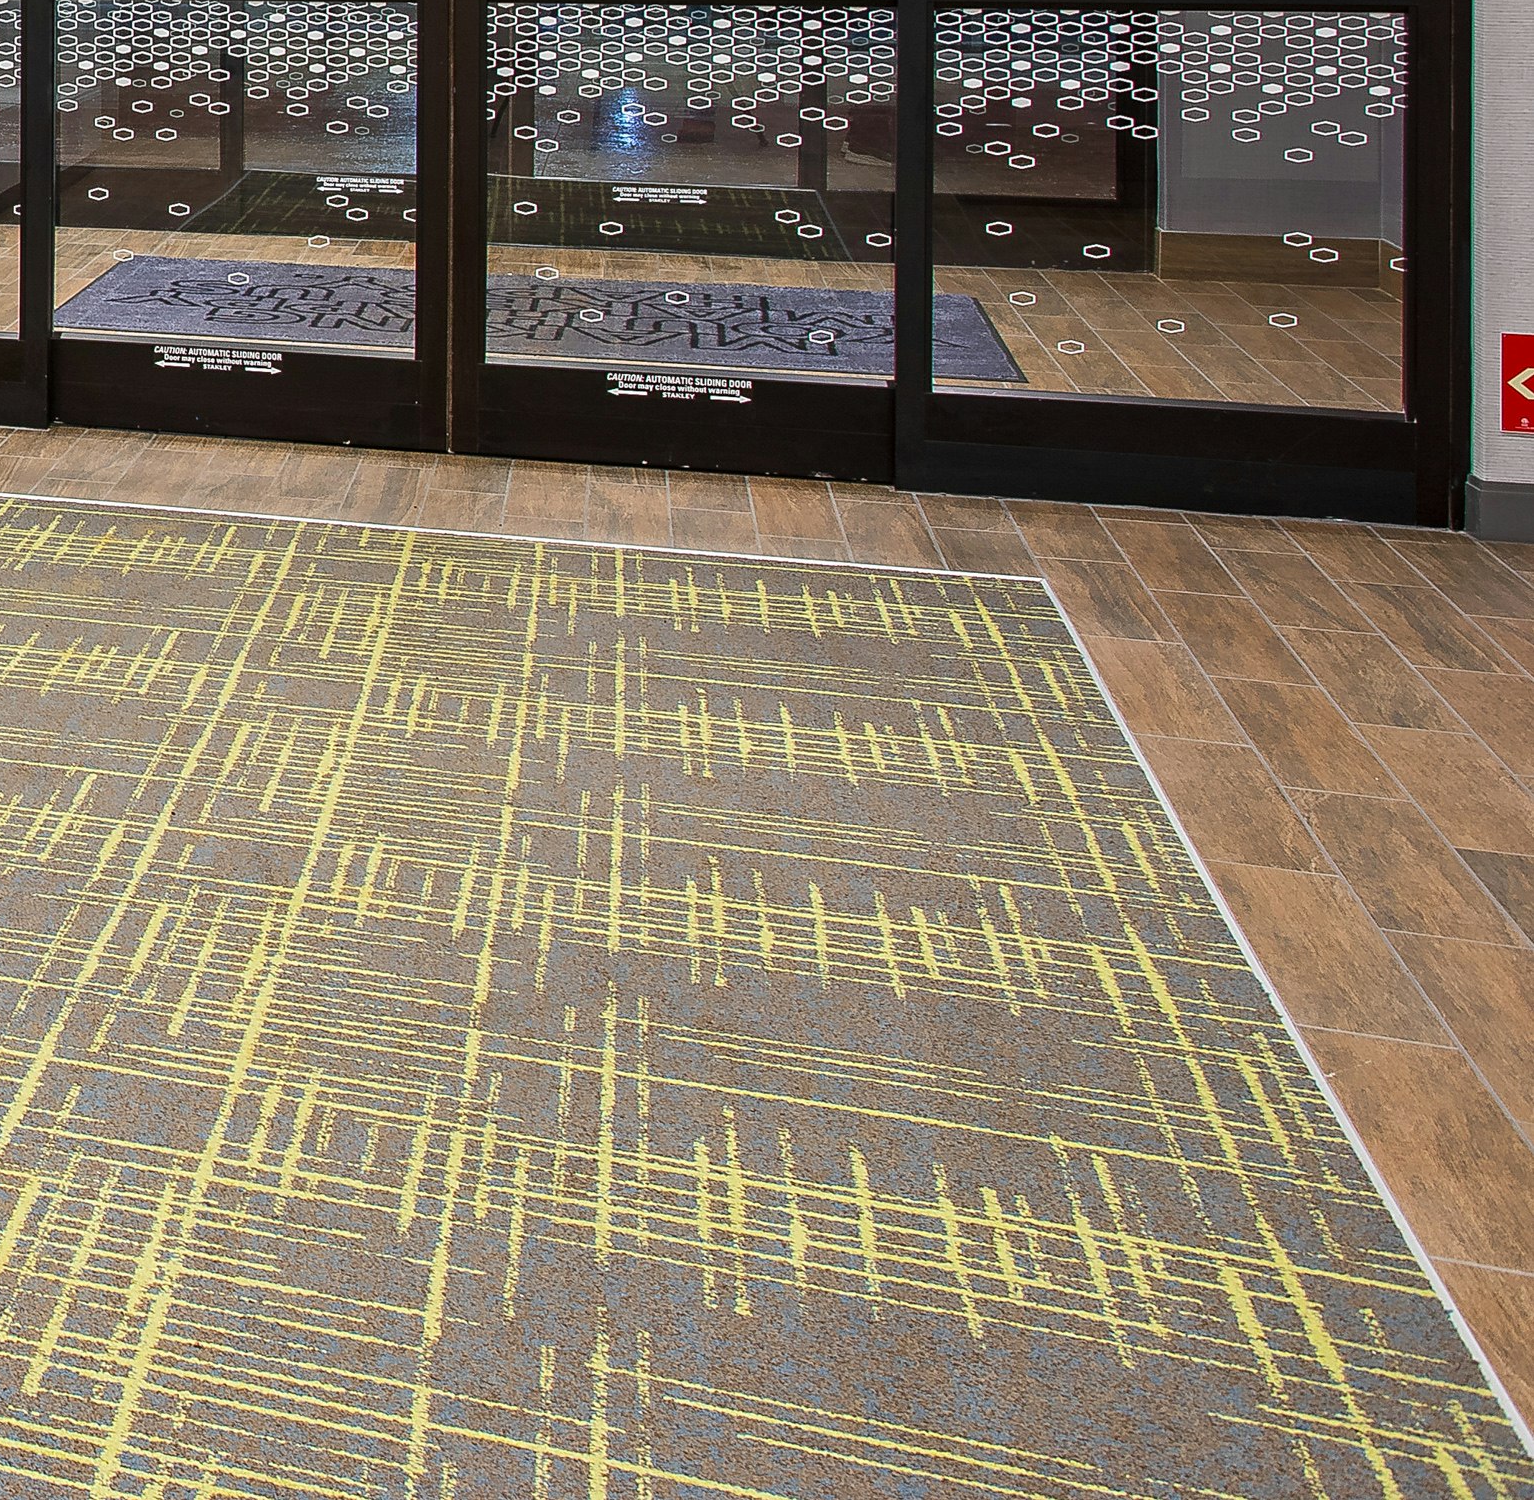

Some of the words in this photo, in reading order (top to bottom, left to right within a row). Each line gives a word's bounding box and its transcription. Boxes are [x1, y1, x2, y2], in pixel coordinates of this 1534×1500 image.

[154, 345, 188, 355] CAUTION:
[188, 348, 230, 357] AUTOMATIC
[232, 350, 260, 359] SLIDING
[262, 352, 282, 361] DOOR
[197, 355, 215, 363] close
[216, 357, 242, 365] without
[243, 360, 272, 368] warning
[607, 372, 645, 382] CAUTION:
[646, 375, 693, 385] AUTOMATIC
[695, 377, 727, 387] SLIDING
[729, 379, 752, 389] DOOR
[618, 380, 636, 389] Door
[637, 383, 653, 392] may
[655, 383, 676, 391] close
[677, 385, 706, 393] without
[708, 387, 740, 396] warning
